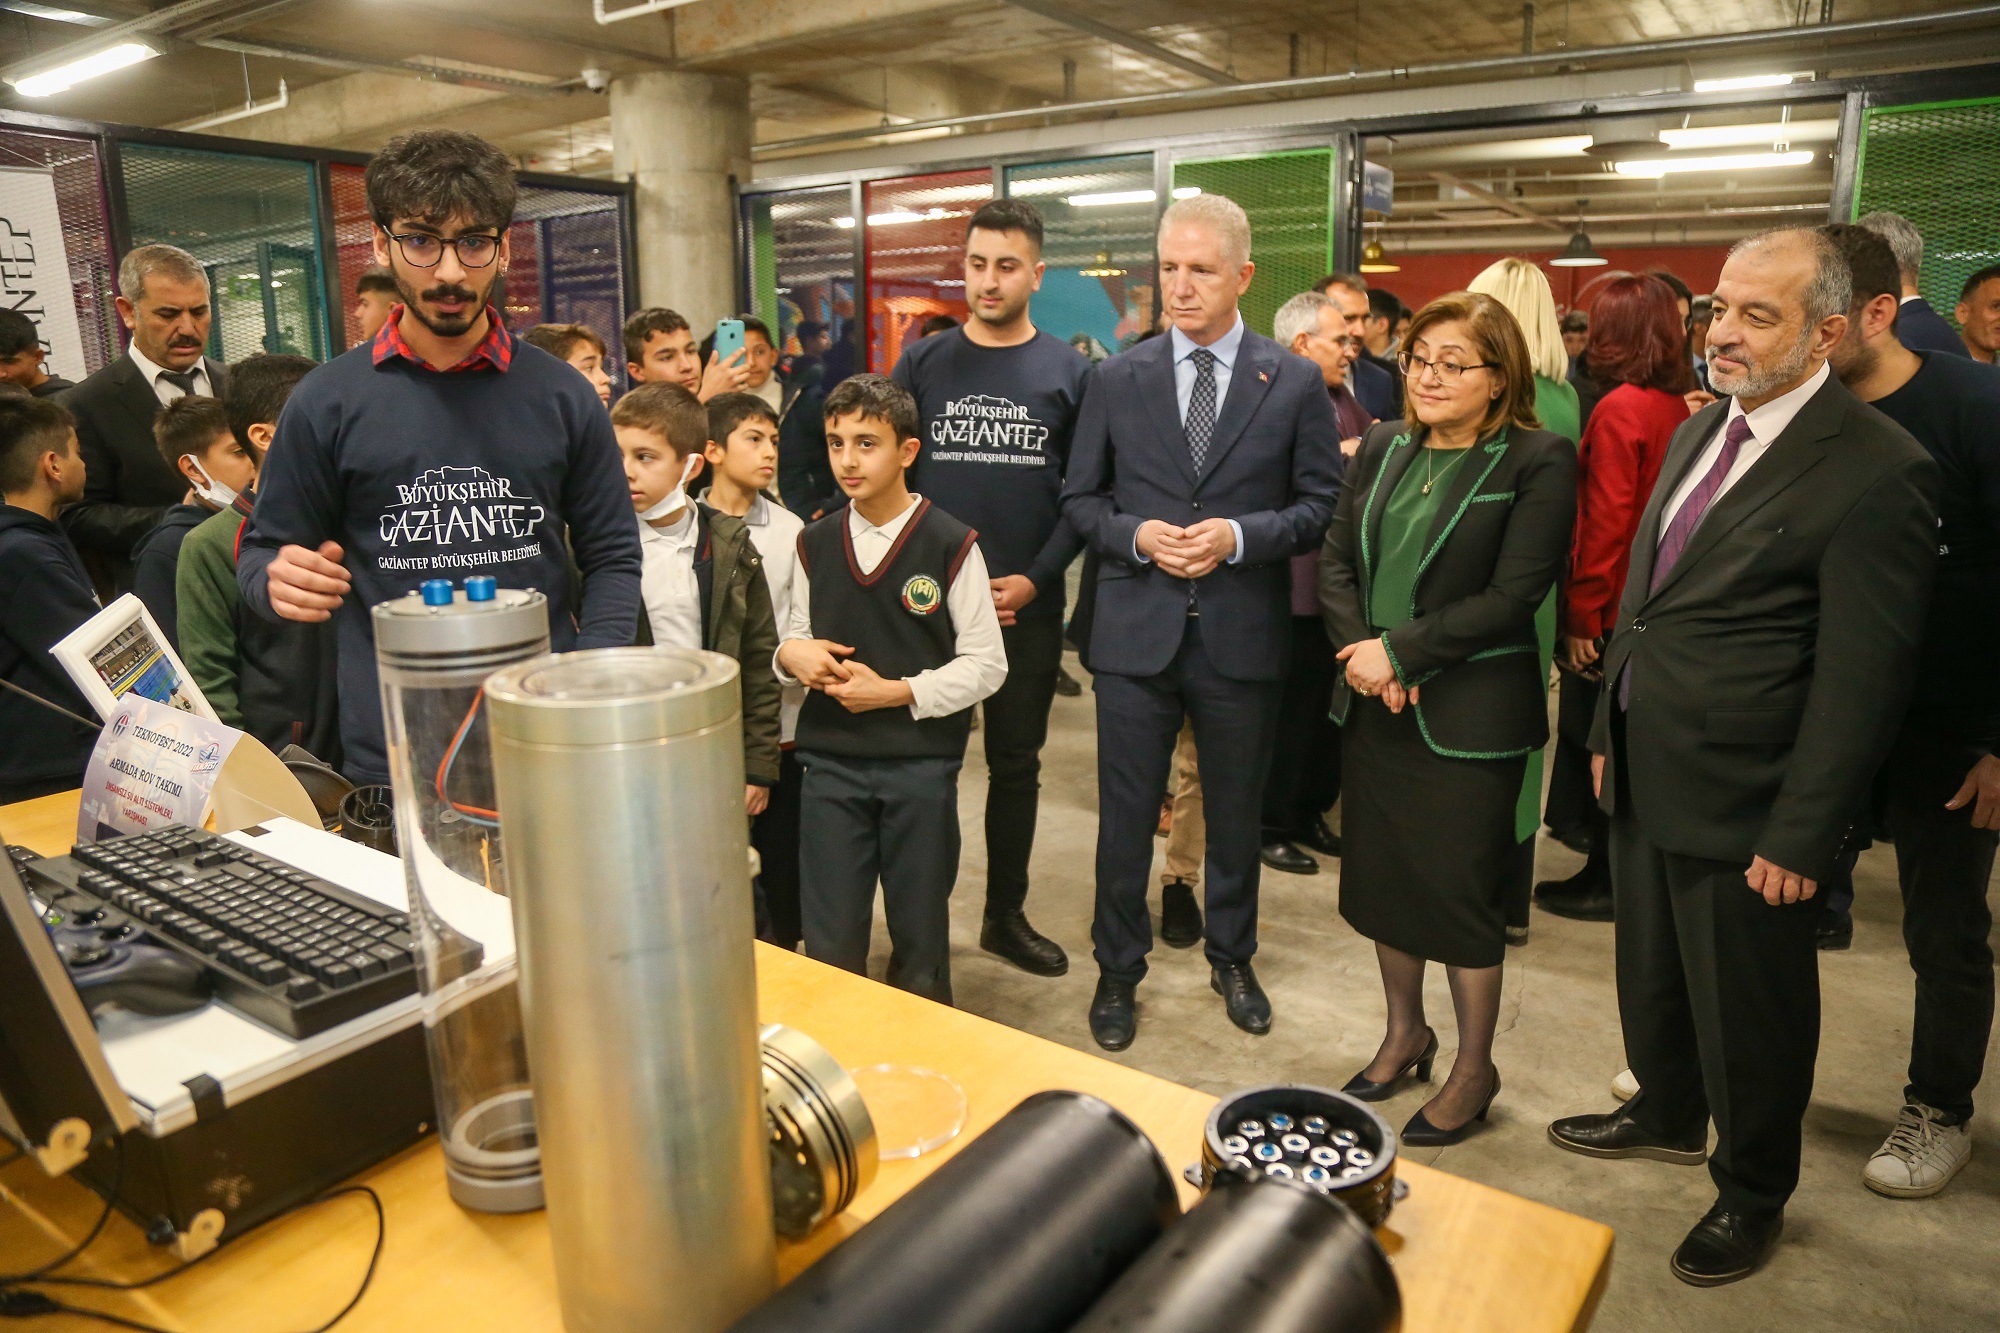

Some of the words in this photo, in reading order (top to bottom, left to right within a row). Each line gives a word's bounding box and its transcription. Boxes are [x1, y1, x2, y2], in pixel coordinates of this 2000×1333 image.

[946, 401, 1029, 420] BÜYÜKŞEHİR
[931, 416, 1049, 450] GAZİANTEP
[932, 450, 963, 461] GAZİANTEP
[963, 451, 1009, 464] BÜYÜKŞEHİR
[1010, 454, 1046, 465] BELEDİYESİ
[396, 477, 513, 505] BÜYÜKŞEHİR
[379, 503, 545, 547] GAZİANTEP
[378, 555, 429, 570] GAZİANTEP
[431, 549, 502, 569] BÜYÜKŞEHİR
[501, 541, 542, 563] BELEDİYESİ
[132, 726, 175, 750] TEKNOFEST
[172, 742, 194, 758] 2022
[109, 758, 137, 780] ARMADA
[138, 768, 156, 785] ROV
[155, 777, 183, 798] TAKIMI
[122, 806, 148, 826] YARIŞMASI
[133, 794, 145, 806] ALTI
[144, 798, 174, 820] SİSTEMLERİ
